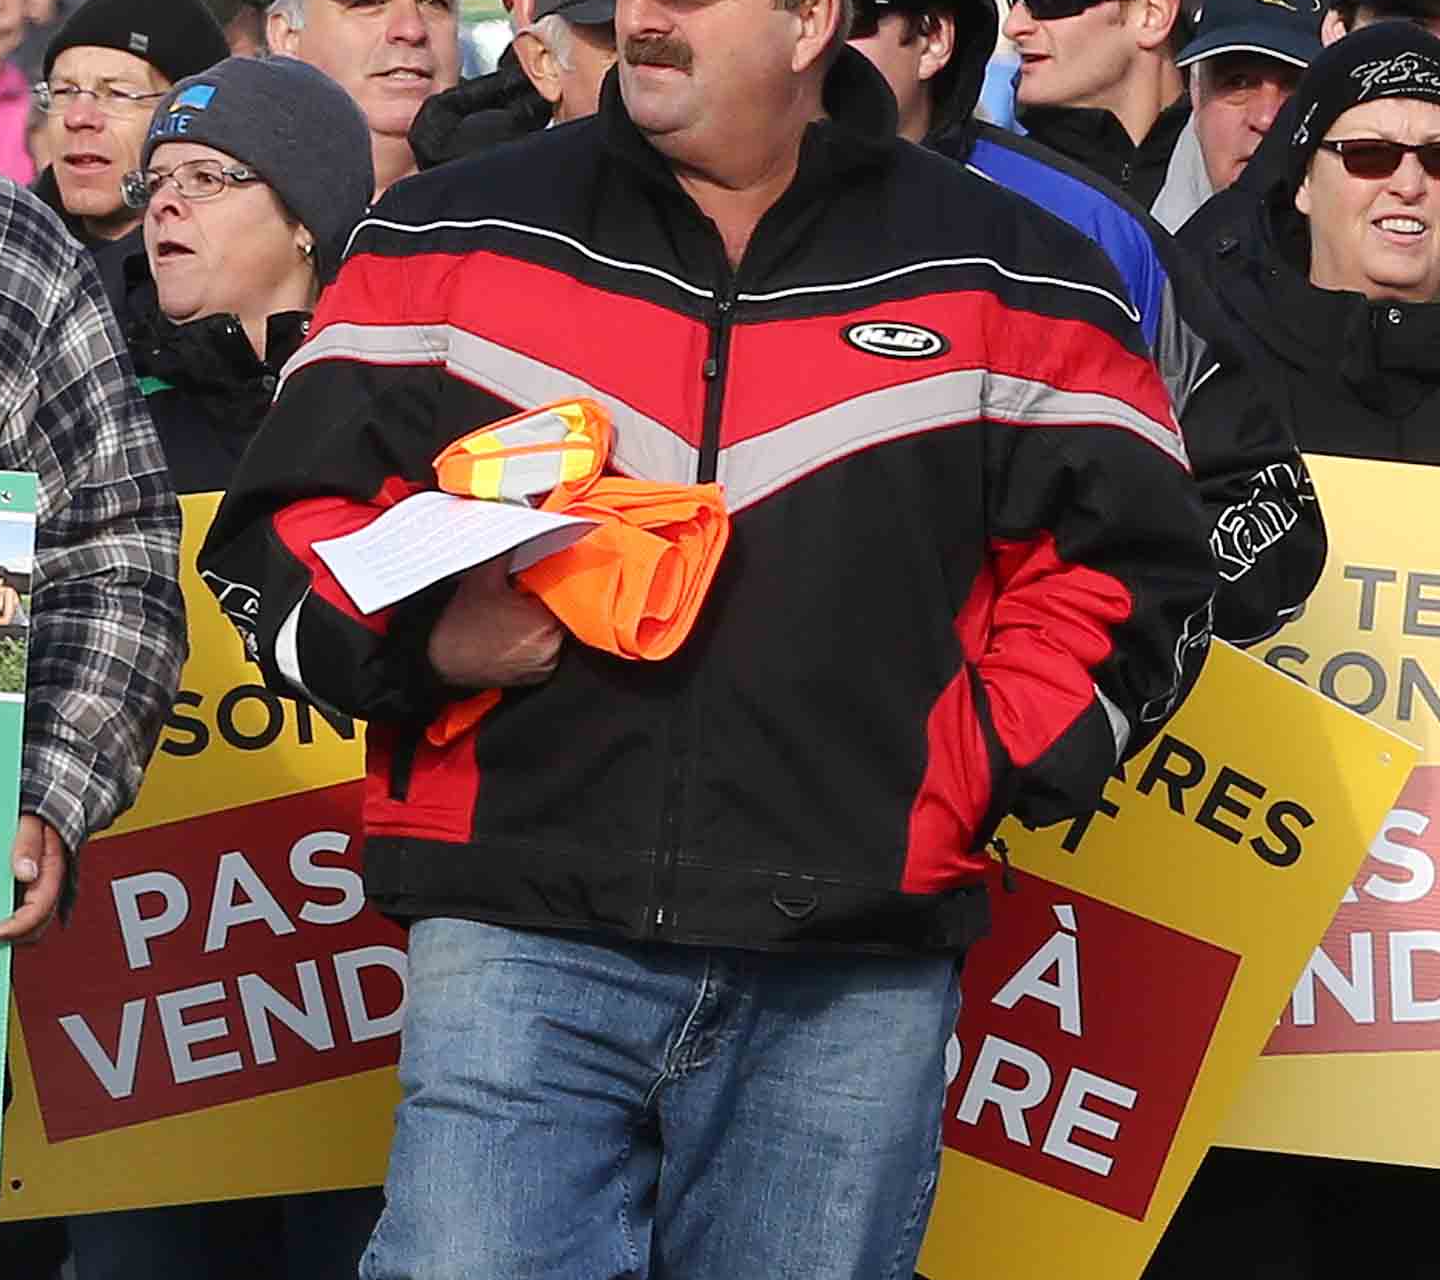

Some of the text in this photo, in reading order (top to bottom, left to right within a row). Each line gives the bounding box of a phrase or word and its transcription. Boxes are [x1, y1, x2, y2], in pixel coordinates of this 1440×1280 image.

[160, 683, 356, 758] SON
[1135, 733, 1317, 869] RES
[110, 829, 367, 971] PAS
[58, 944, 410, 1101] VEND
[990, 904, 1083, 1038] À
